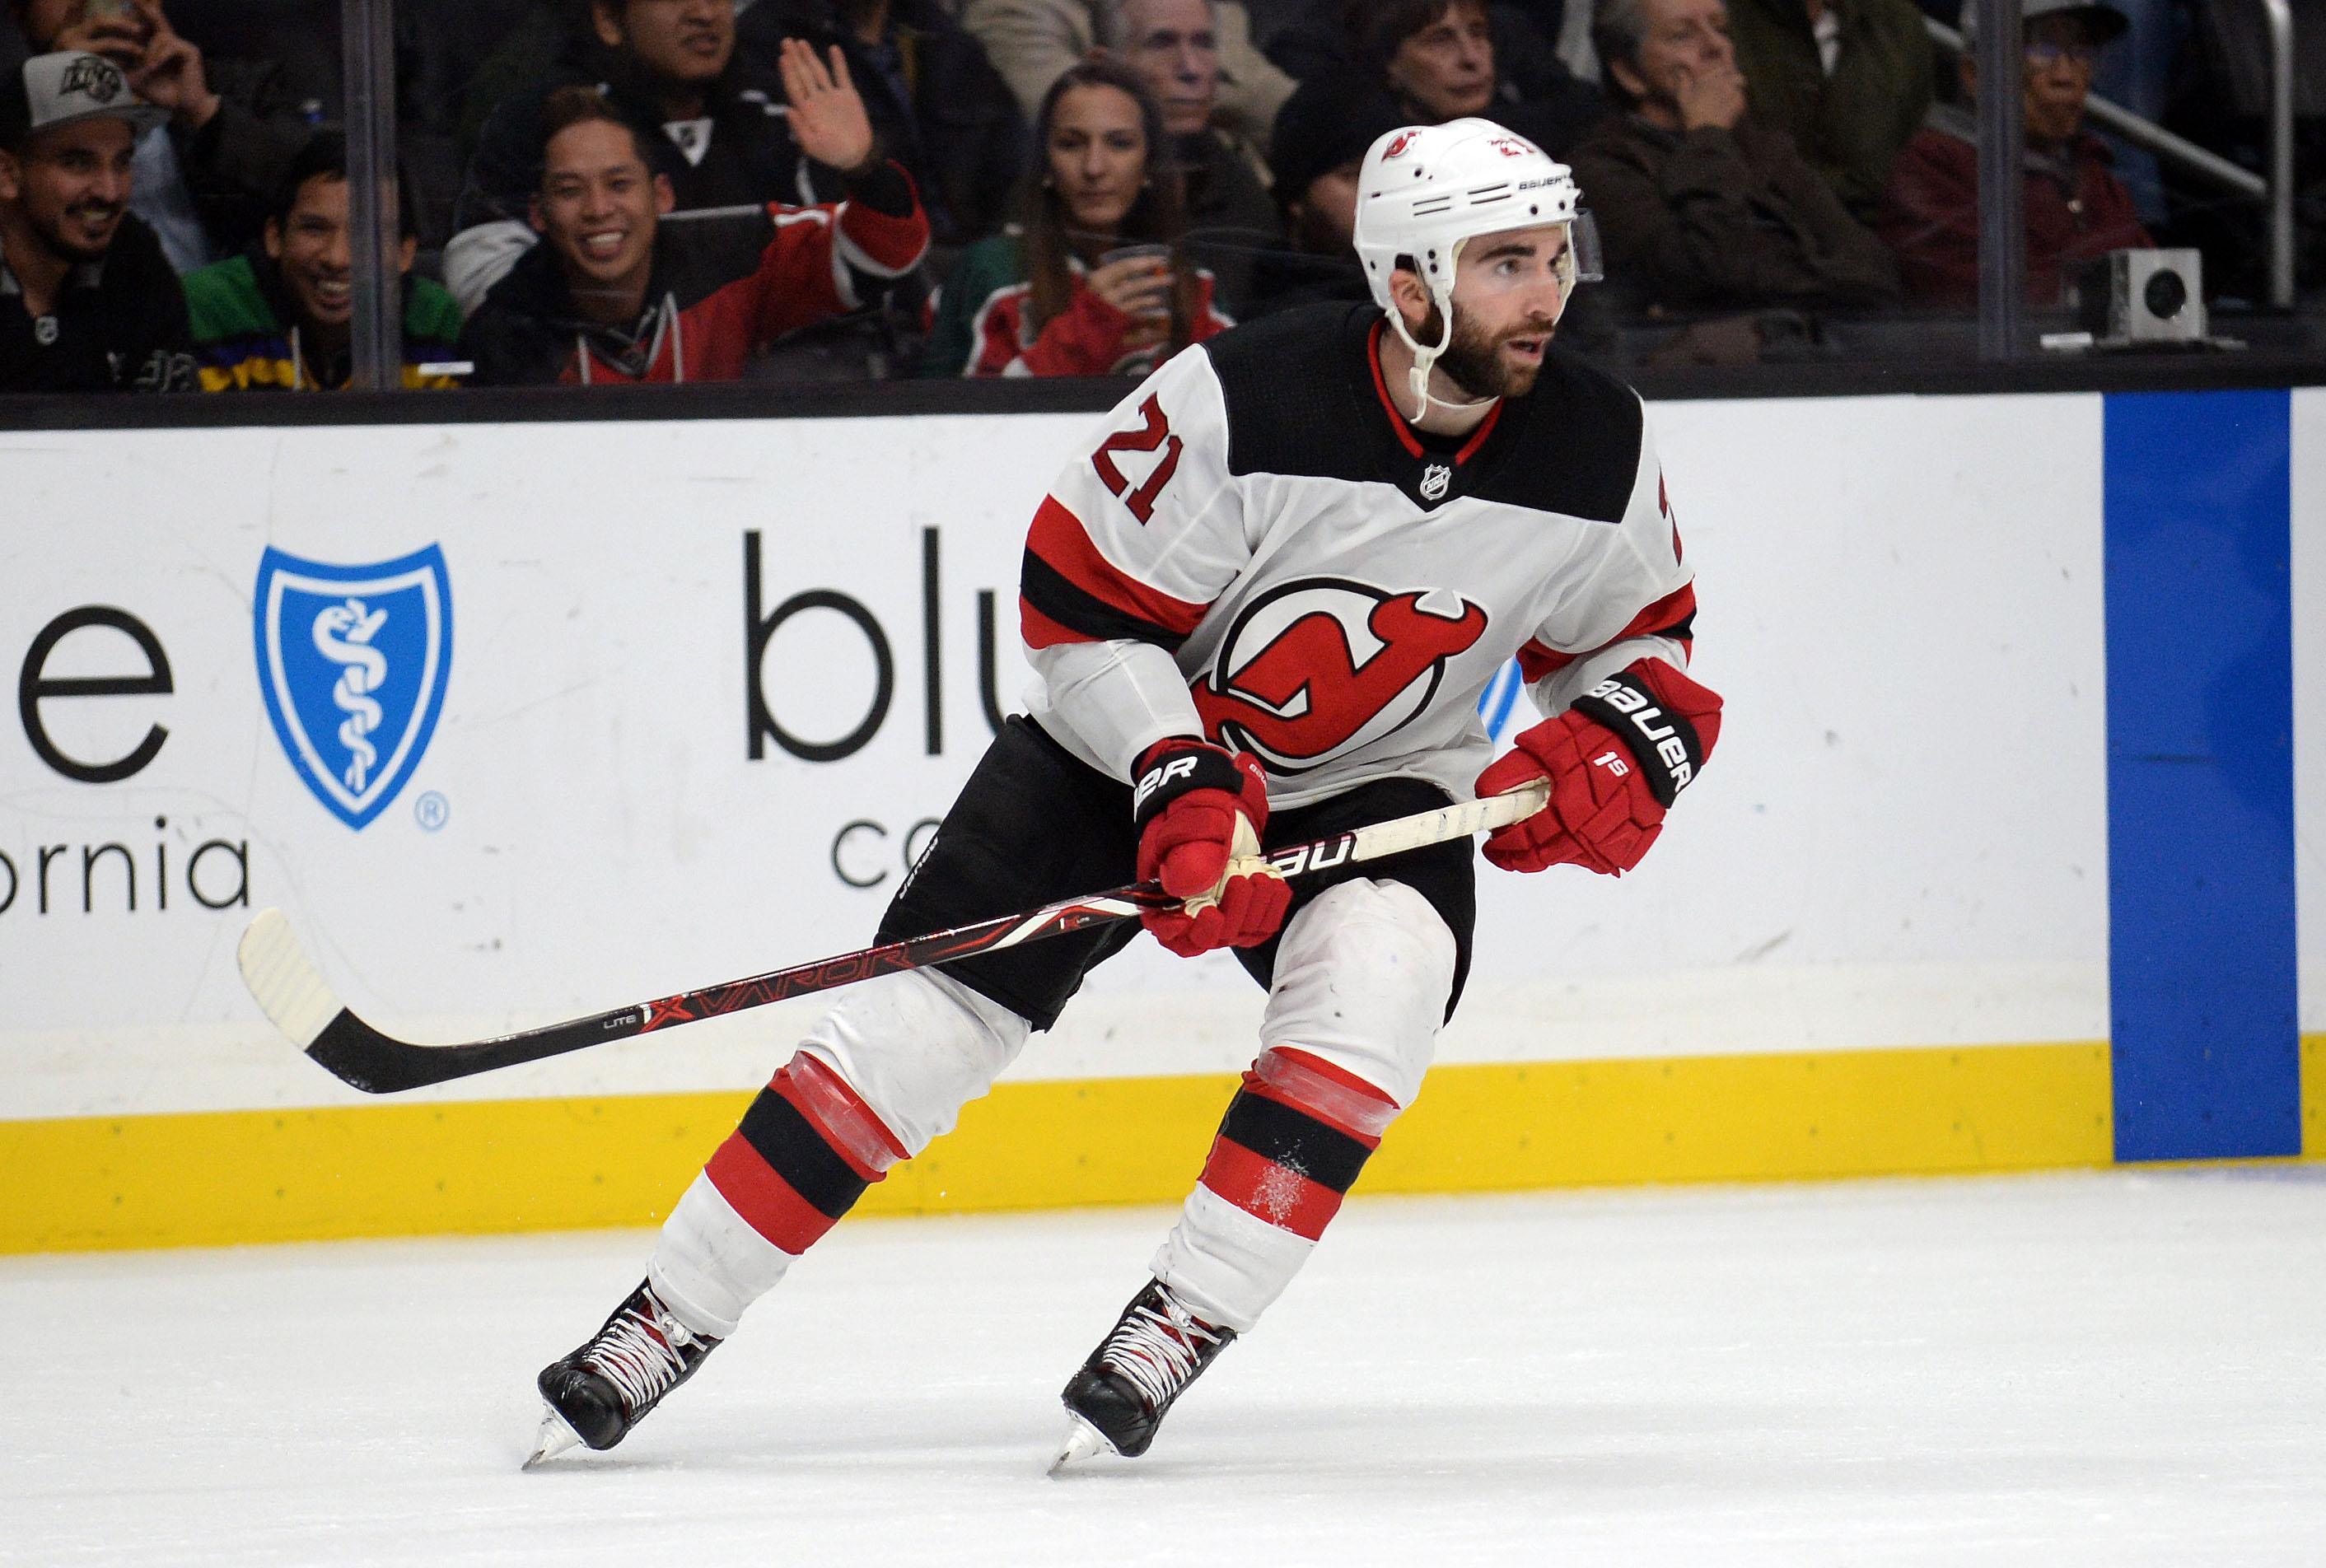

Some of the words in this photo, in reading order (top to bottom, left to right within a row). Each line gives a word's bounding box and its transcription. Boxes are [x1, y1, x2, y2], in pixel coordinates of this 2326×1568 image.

[1091, 390, 1184, 526] 21
[1583, 679, 1692, 793] BAUER
[603, 1015, 636, 1029] LITE
[694, 943, 915, 1015] VAPOR
